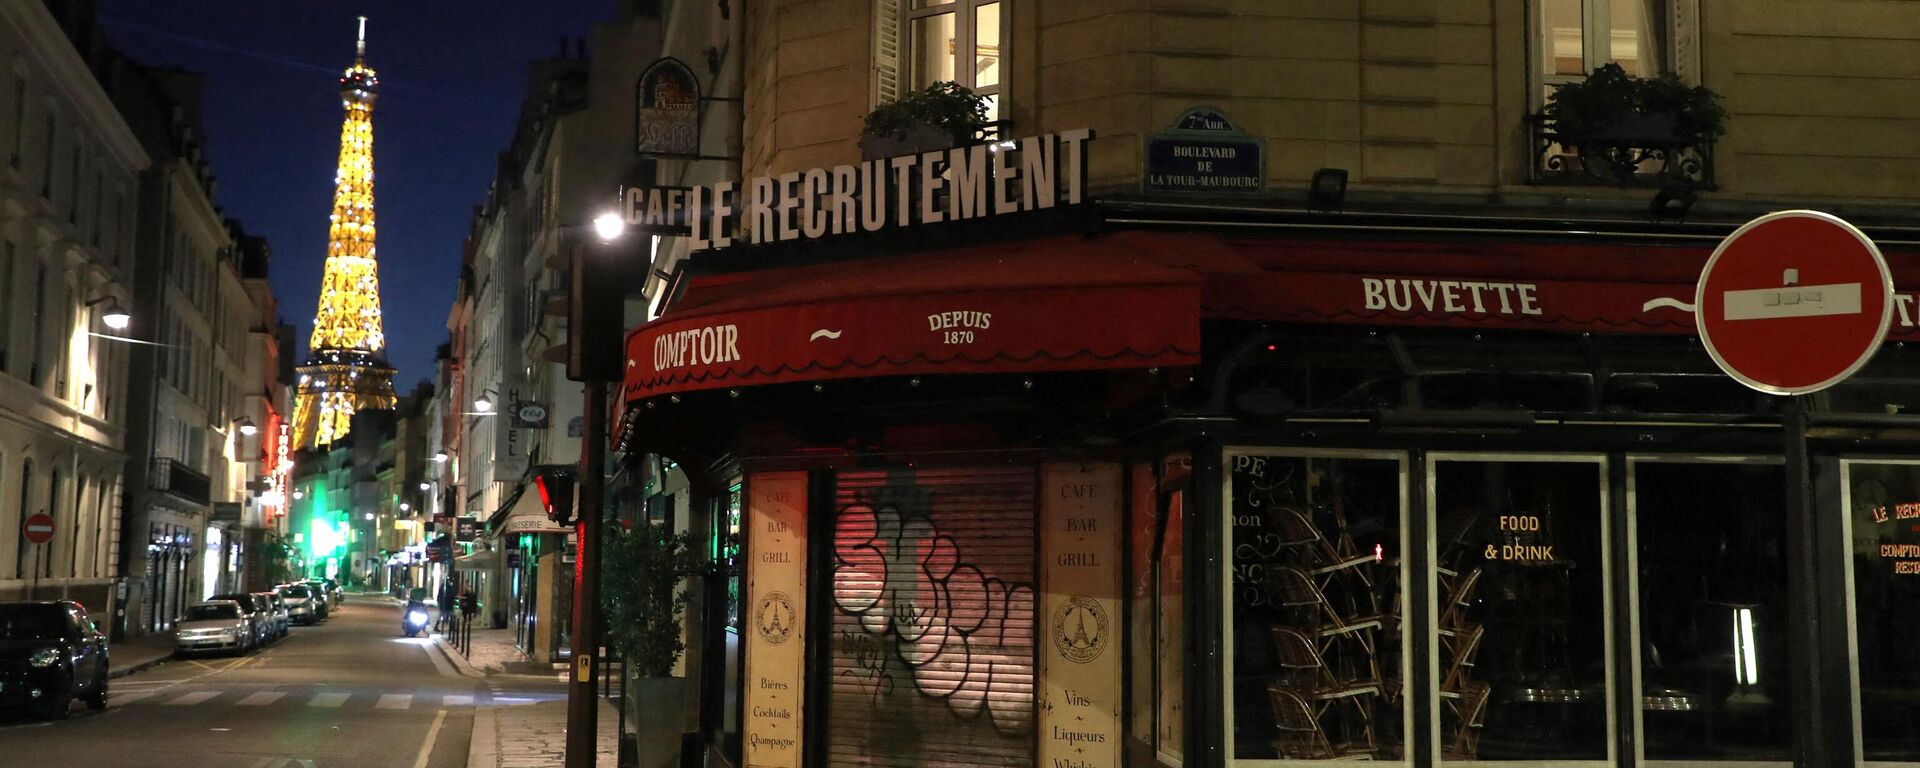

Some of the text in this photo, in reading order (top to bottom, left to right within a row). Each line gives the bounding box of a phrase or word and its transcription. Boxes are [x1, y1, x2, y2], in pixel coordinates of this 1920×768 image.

[1174, 146, 1236, 158] BOULEVARD
[1197, 161, 1213, 172] DE
[1150, 174, 1259, 187] LA TOUR-MAUBOURG
[691, 128, 1091, 250] LE RECRUTEMENT
[1362, 278, 1542, 315] BUVETTE
[1893, 294, 1920, 327] T
[928, 311, 991, 332] DEPUIS
[943, 331, 974, 345] 1870
[654, 323, 740, 373] COMPTOIR
[508, 388, 519, 457] HOTEL
[1871, 504, 1889, 523] LE
[767, 521, 788, 533] BAR
[1066, 518, 1097, 532] BAR
[1500, 515, 1540, 531] FOOD
[762, 551, 792, 564] GRILL
[1057, 552, 1101, 567] GRILL
[1484, 544, 1554, 561] & DRINK
[1894, 560, 1920, 575] REST
[1063, 689, 1091, 707] Vins
[753, 705, 791, 719] Cocktails
[750, 732, 795, 751] Champagne
[1053, 725, 1106, 746] Liqueurs
